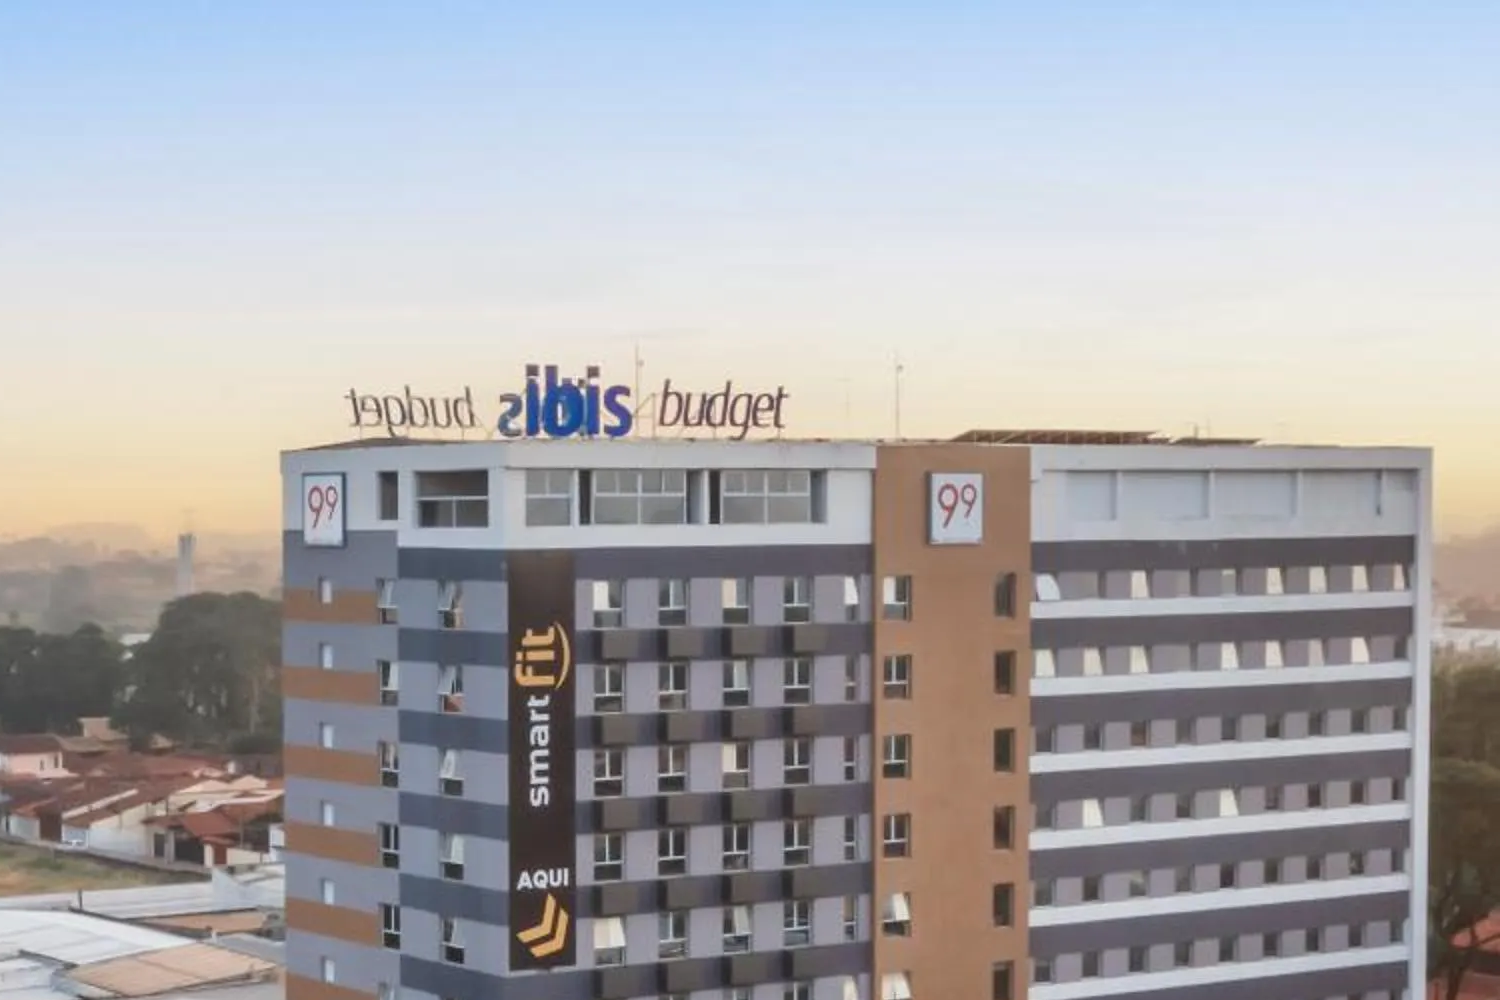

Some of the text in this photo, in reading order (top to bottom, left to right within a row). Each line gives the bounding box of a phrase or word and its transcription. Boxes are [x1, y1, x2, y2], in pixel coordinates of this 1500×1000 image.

[525, 364, 790, 440] ibis budget
[514, 624, 556, 808] smart fit
[516, 867, 569, 891] AQUI
